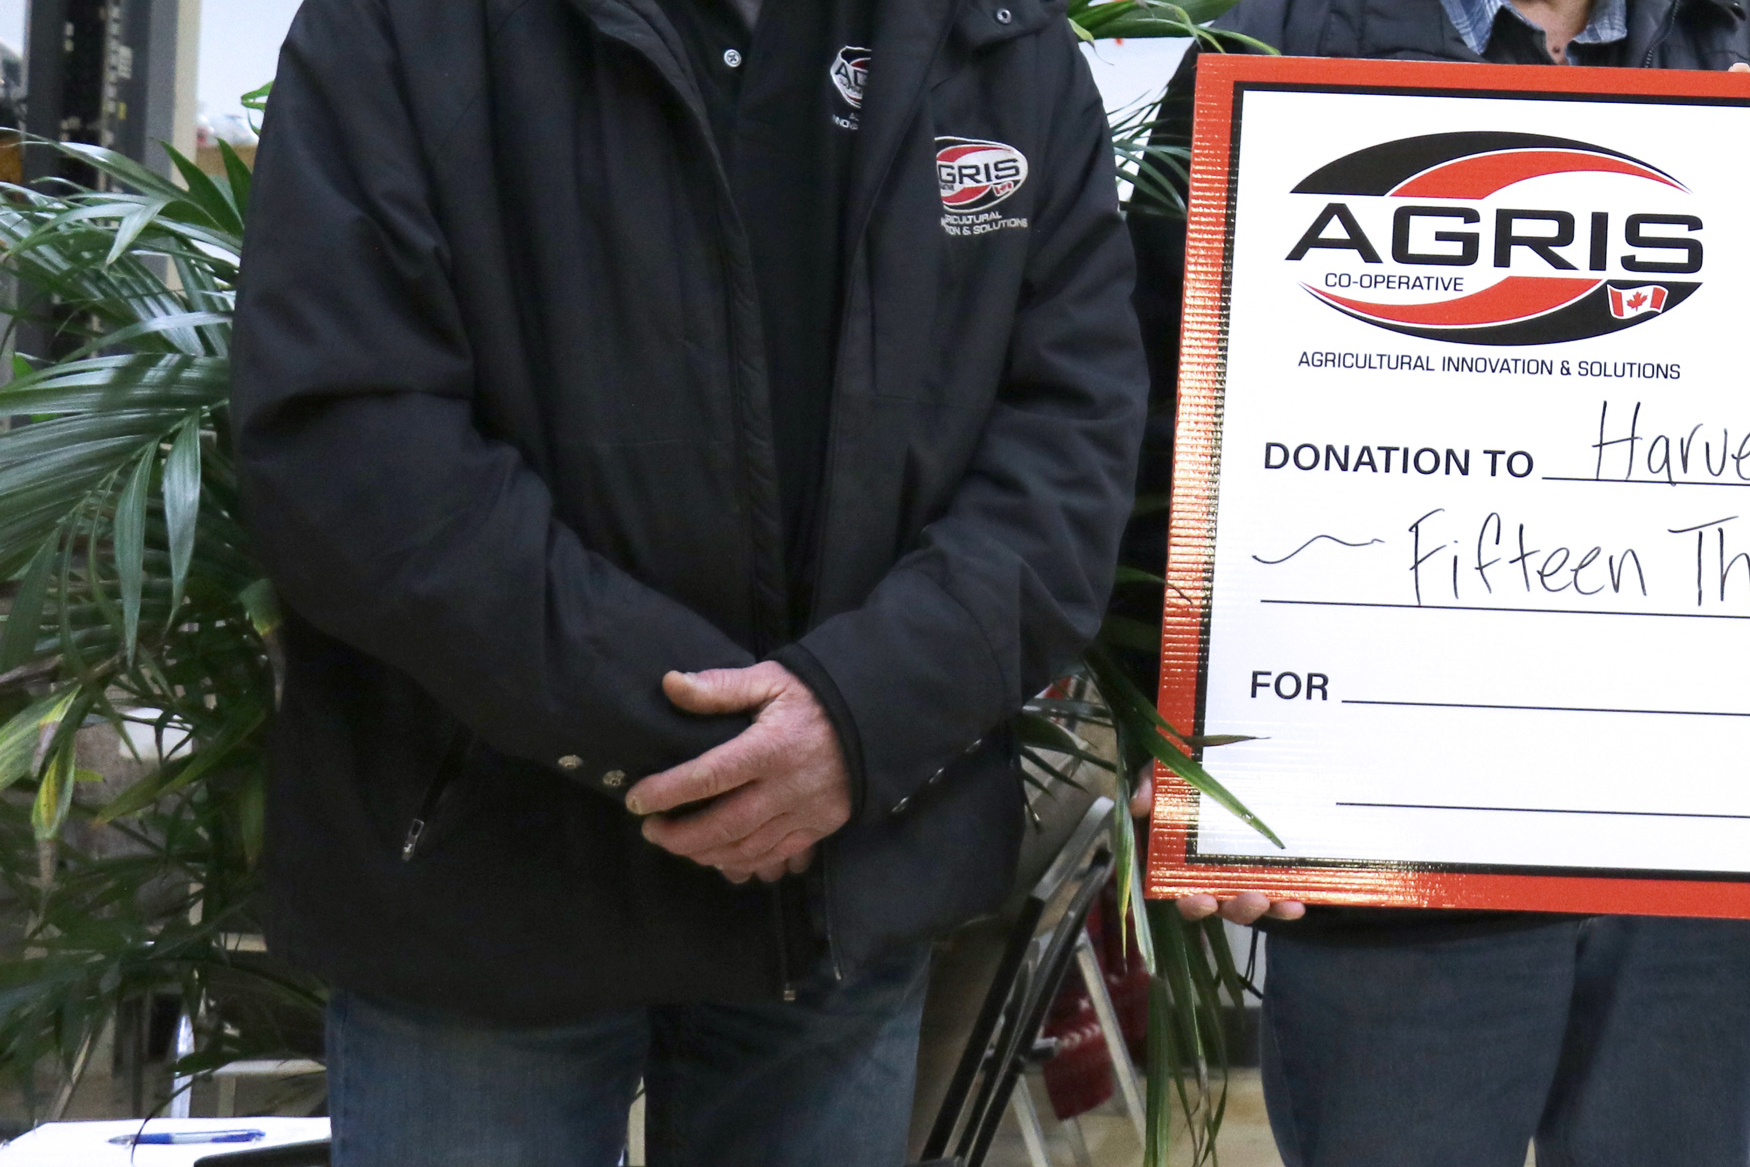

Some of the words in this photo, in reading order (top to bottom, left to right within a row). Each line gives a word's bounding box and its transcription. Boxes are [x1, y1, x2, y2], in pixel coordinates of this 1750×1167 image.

[938, 159, 1020, 184] GRIS
[944, 211, 1002, 225] RICULTURAL
[973, 218, 1028, 234] SOLUTIONS
[1284, 202, 1704, 275] AGRIS
[1324, 272, 1464, 293] CO-OPERATIVE
[1298, 351, 1435, 371] AGRICULTURAL
[1442, 356, 1553, 376] INNOVATION
[1560, 360, 1572, 376] &
[1578, 360, 1681, 380] SOLUTIONS
[1264, 442, 1470, 476] DONATION
[1483, 449, 1534, 478] TO
[1408, 508, 1647, 606] Fifteen
[1250, 671, 1329, 701] FOR
